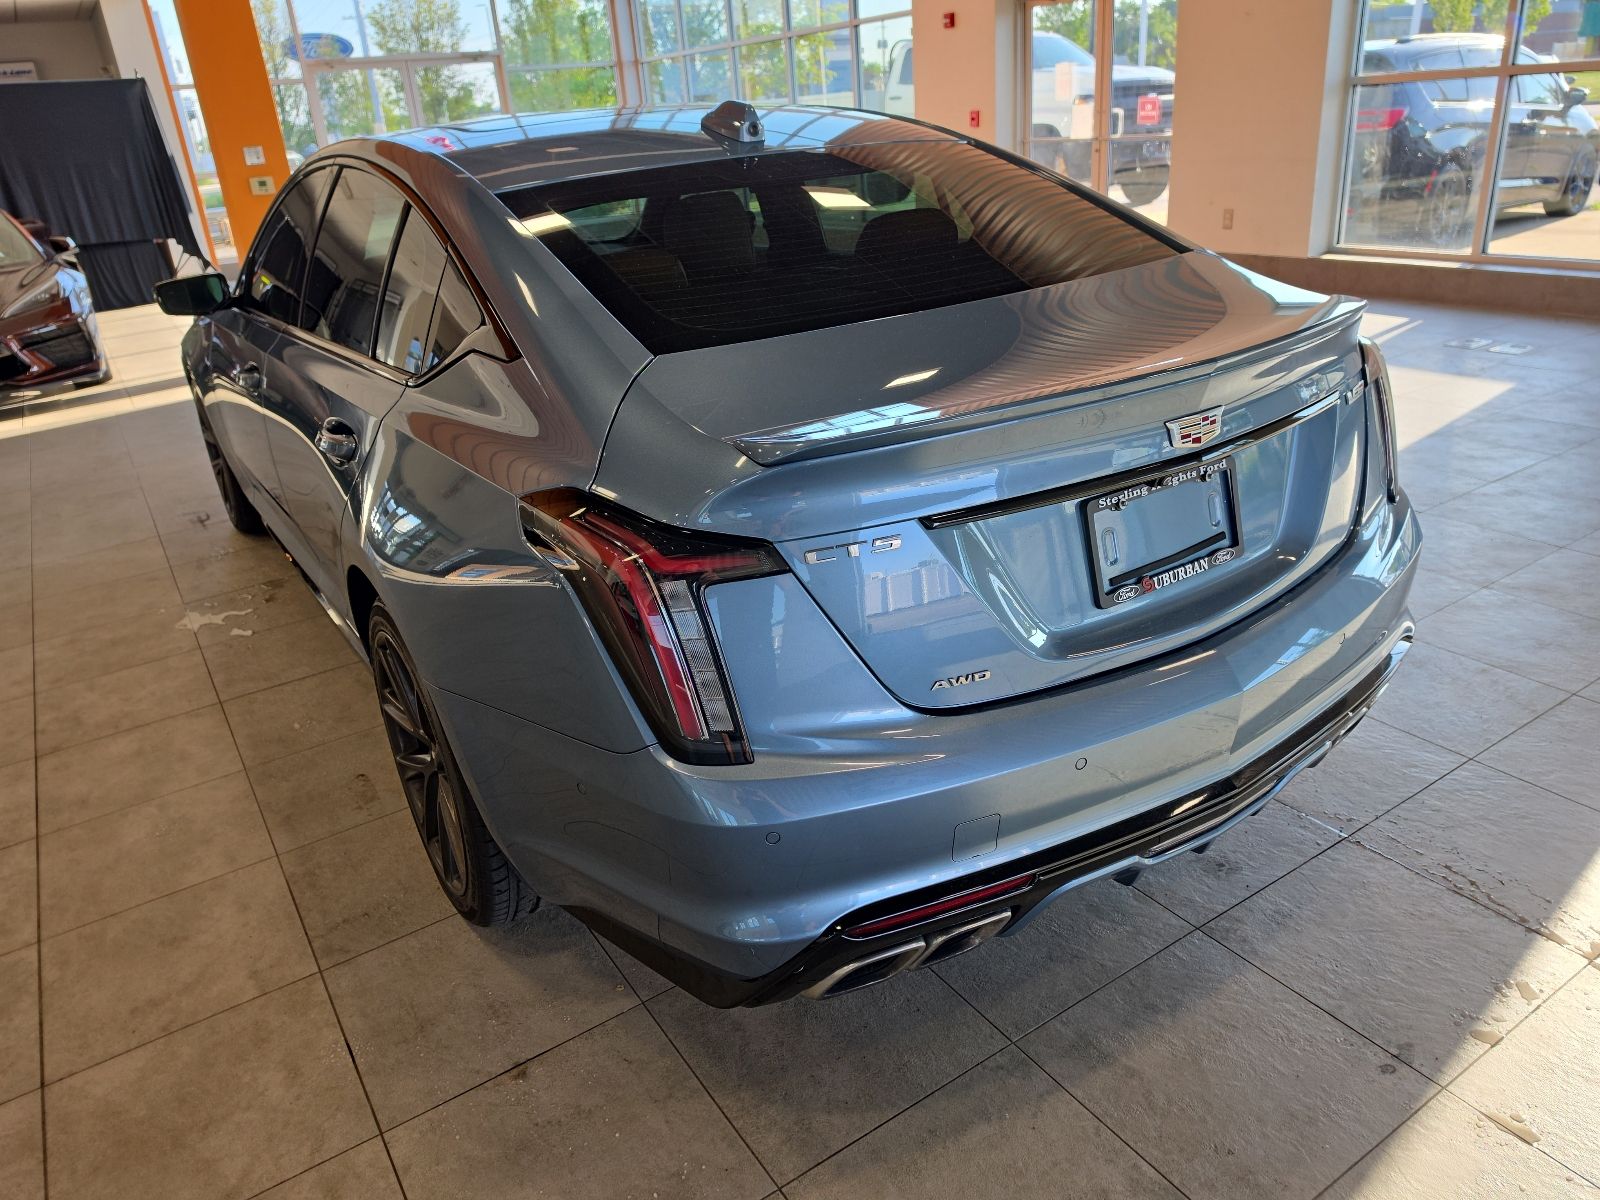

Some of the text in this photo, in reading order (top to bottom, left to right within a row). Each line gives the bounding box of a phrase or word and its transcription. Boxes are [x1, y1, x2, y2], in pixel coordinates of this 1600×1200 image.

[1098, 459, 1227, 508] Sterling ghts Ford
[804, 534, 902, 565] CT5
[1142, 558, 1209, 594] SUBURBAN
[930, 670, 991, 691] AWD
